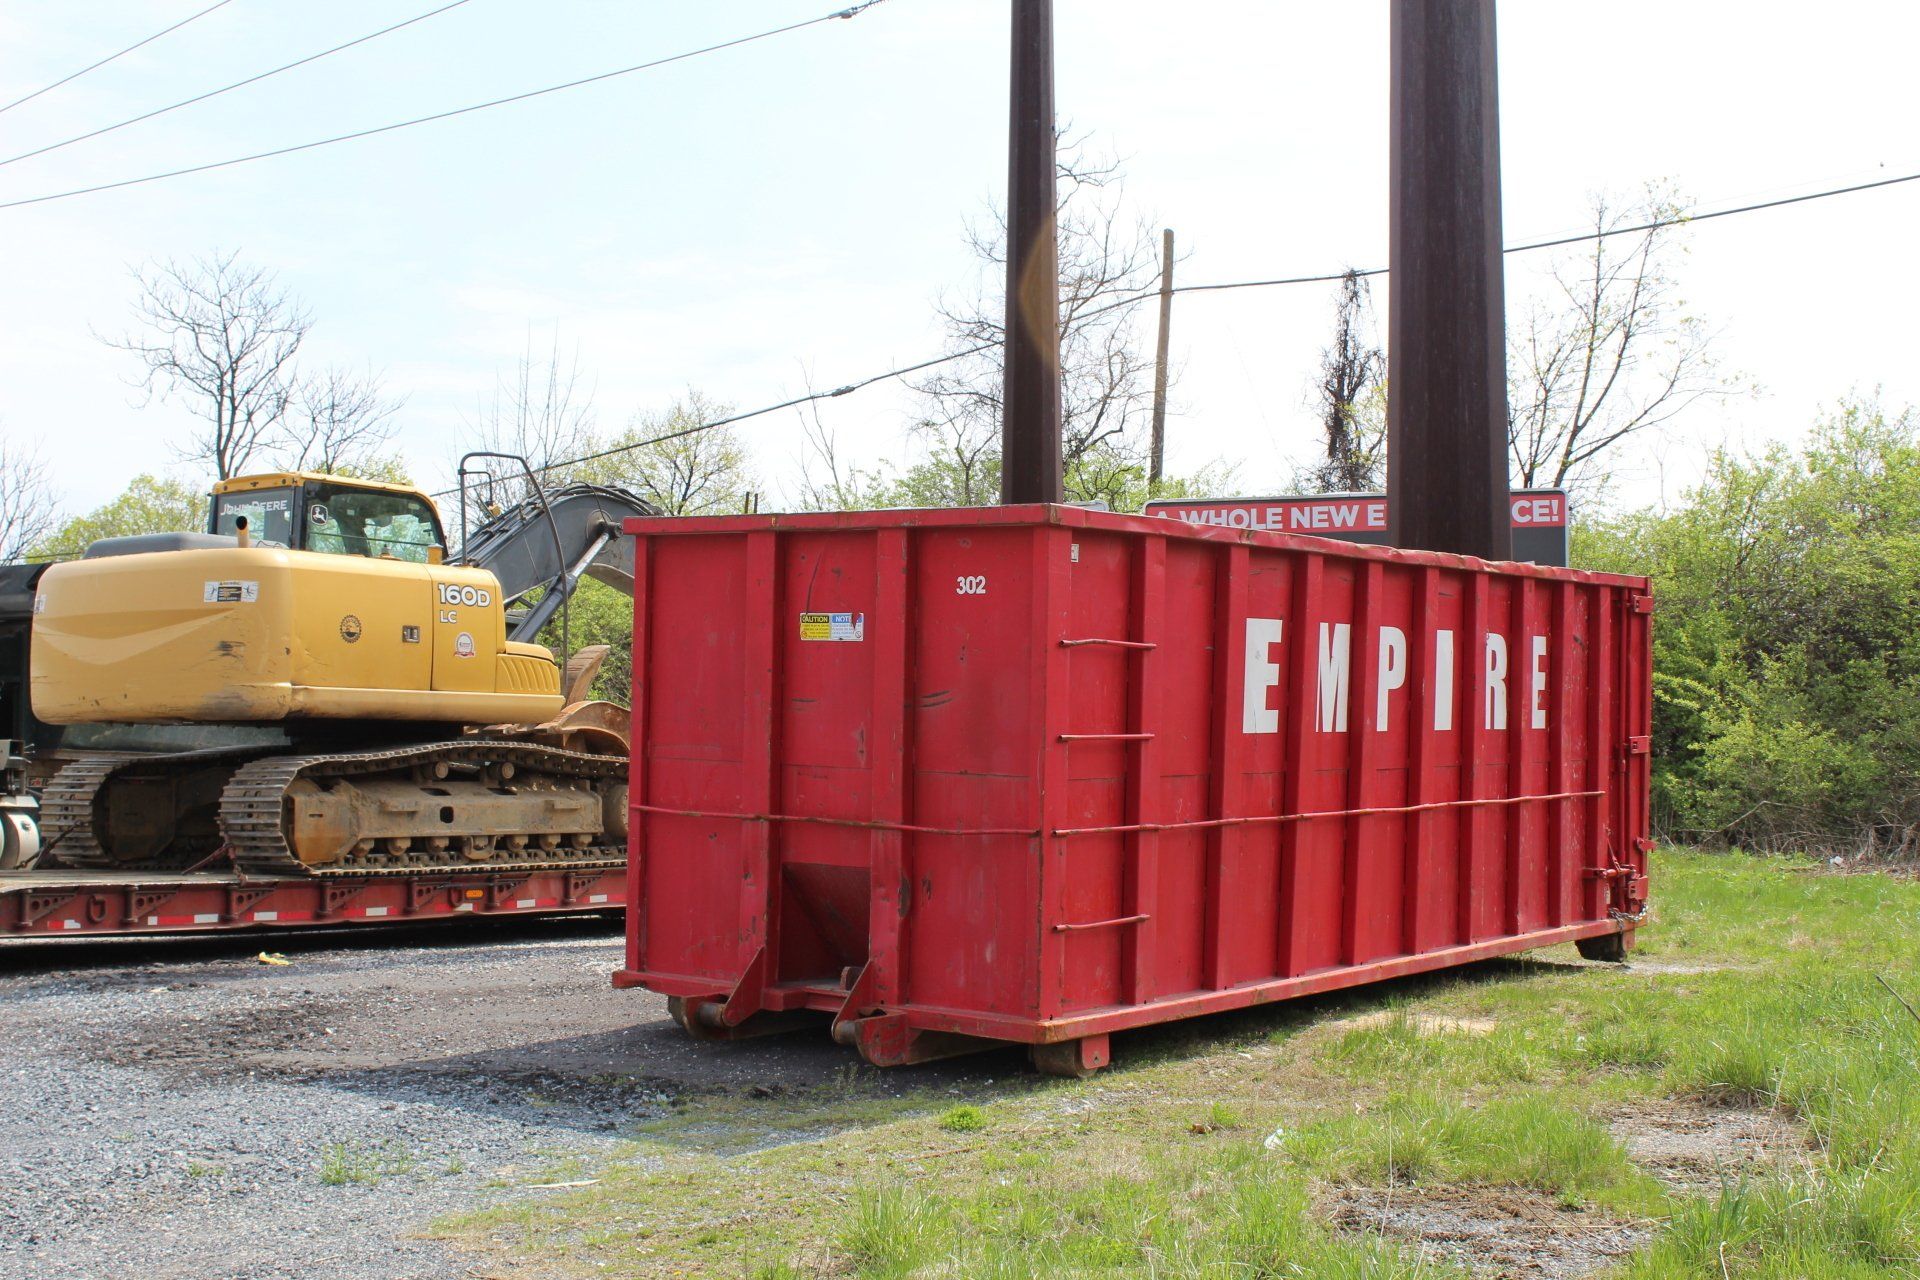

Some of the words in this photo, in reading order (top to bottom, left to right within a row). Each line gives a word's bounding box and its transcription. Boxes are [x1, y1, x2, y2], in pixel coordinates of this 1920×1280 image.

[251, 500, 288, 512] DEERE
[1180, 508, 1283, 530] WHOLE
[1290, 504, 1360, 529] NEW
[438, 582, 491, 608] 160D
[956, 575, 987, 595] 302
[440, 609, 457, 624] LC
[802, 615, 829, 623] CAUTION
[1241, 617, 1547, 734] EMPIRE
